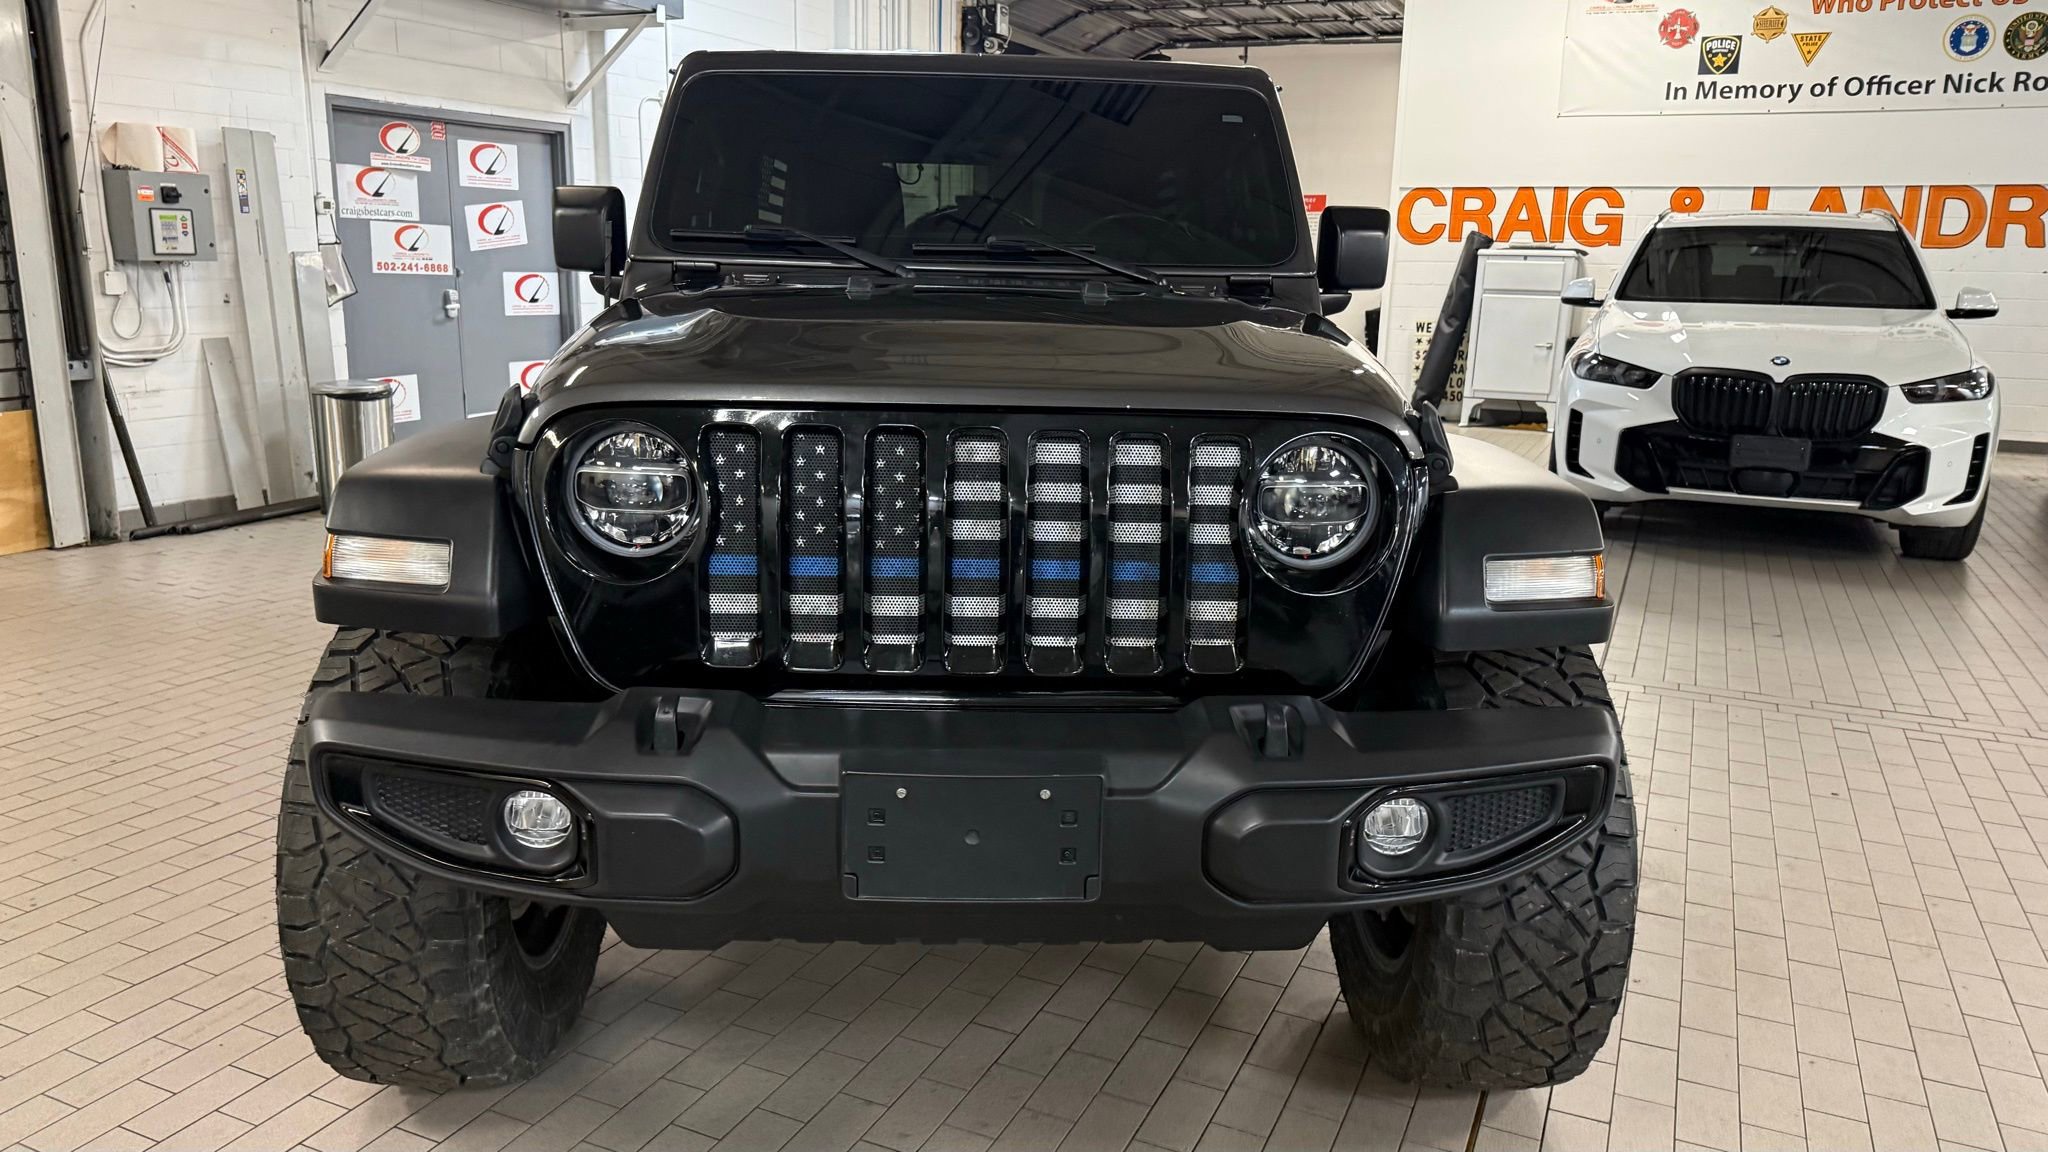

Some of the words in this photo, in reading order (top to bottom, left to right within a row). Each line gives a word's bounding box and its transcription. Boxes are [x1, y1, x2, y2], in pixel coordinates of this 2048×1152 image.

[1812, 0, 1873, 14] Who
[1759, 19, 1780, 28] SHERIFF
[1706, 39, 1737, 51] POLICE
[1665, 81, 1688, 101] In
[1695, 81, 1803, 103] Memory
[1810, 76, 1839, 98] of
[1844, 74, 1936, 97] Officer
[1943, 72, 2006, 94] Nick
[2012, 71, 2048, 92] Ro
[341, 206, 413, 218] craigsbestcars.com
[1397, 187, 1625, 247] CRAIG
[377, 261, 448, 273] 502-241-6868
[1416, 322, 1432, 333] WE
